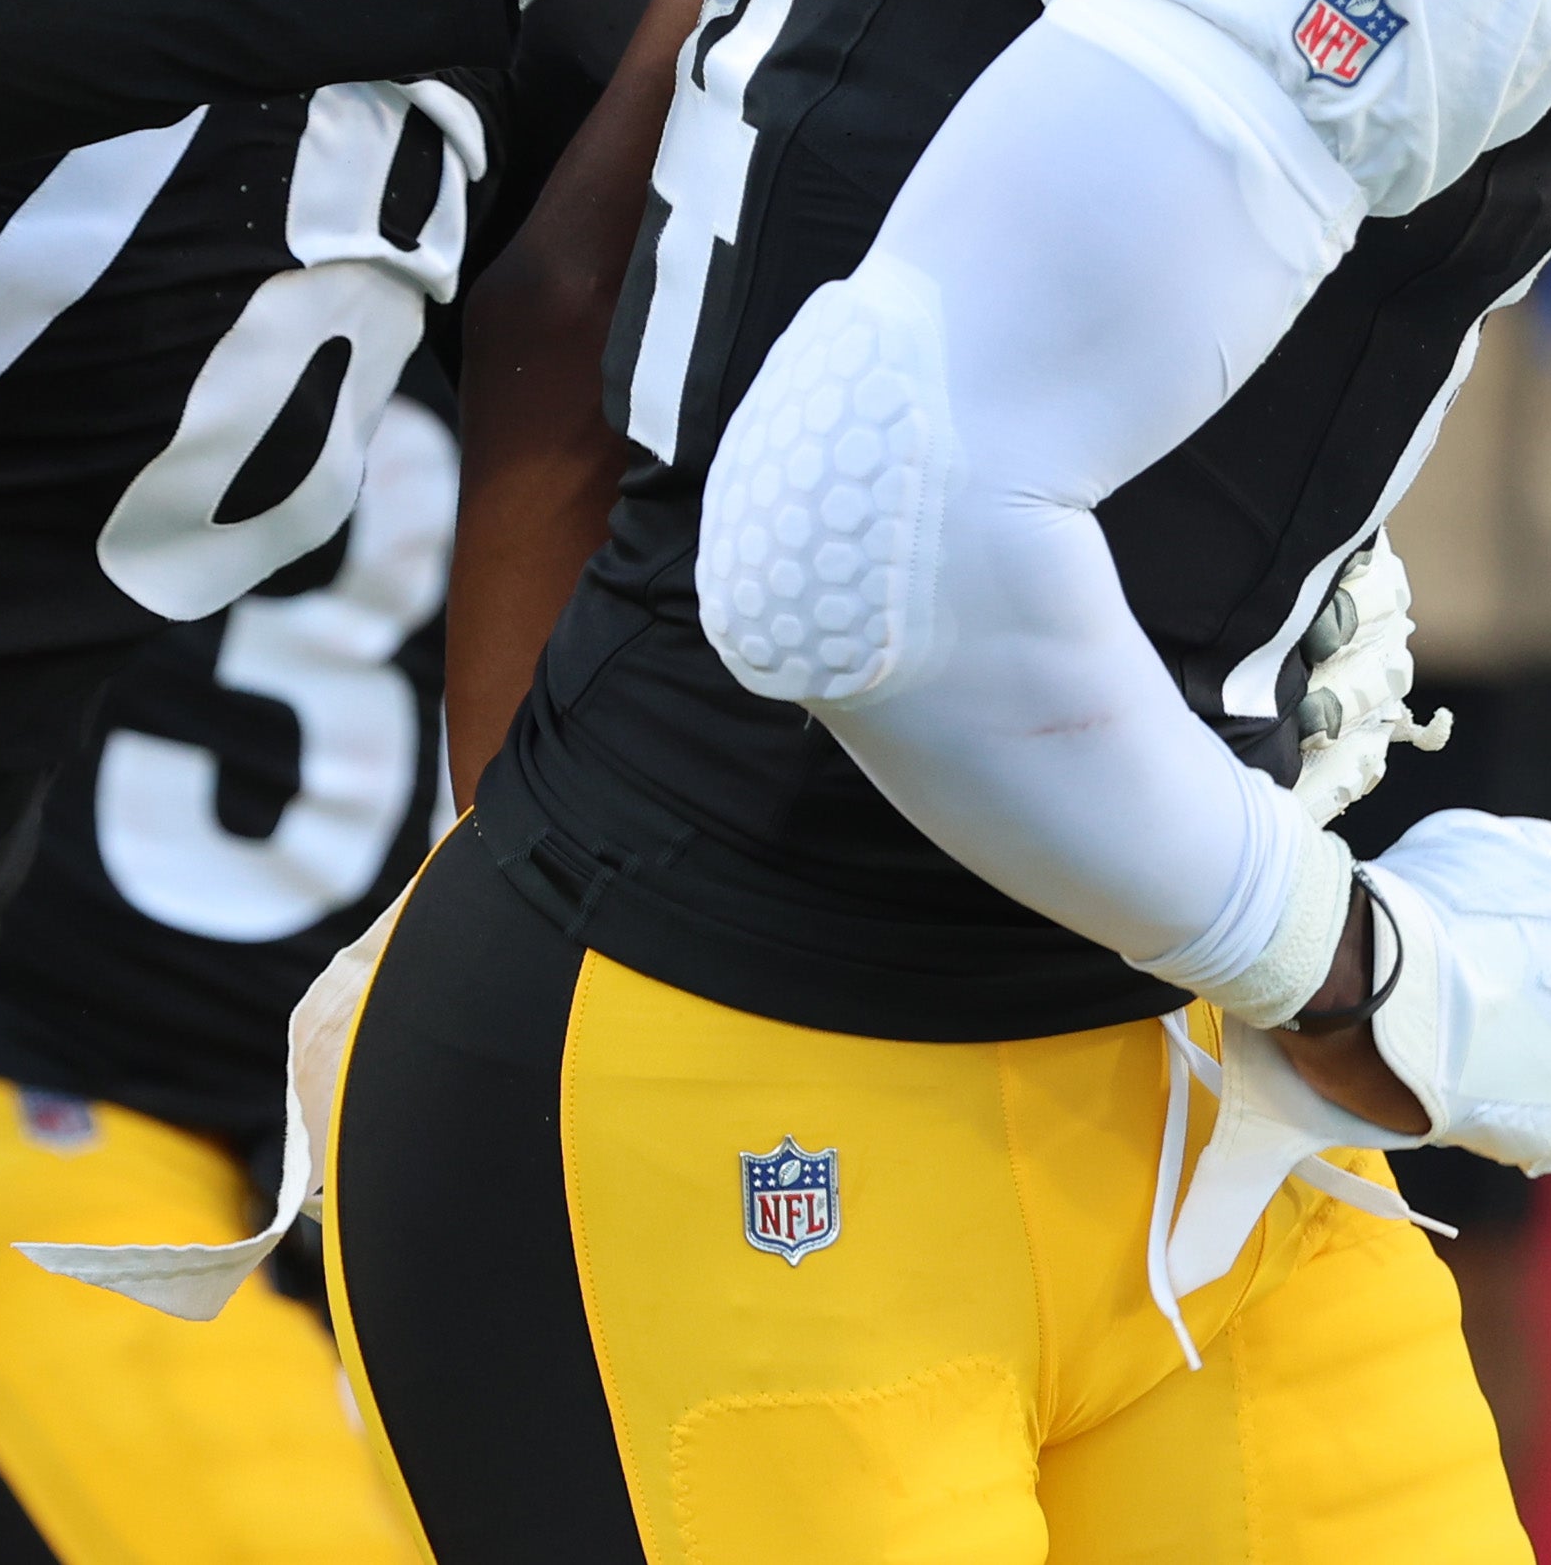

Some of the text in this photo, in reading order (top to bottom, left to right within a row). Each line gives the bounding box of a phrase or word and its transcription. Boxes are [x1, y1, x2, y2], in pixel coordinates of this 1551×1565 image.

[1297, 2, 1369, 80] NFL
[94, 394, 459, 942] 3
[757, 1192, 825, 1241] NFL
